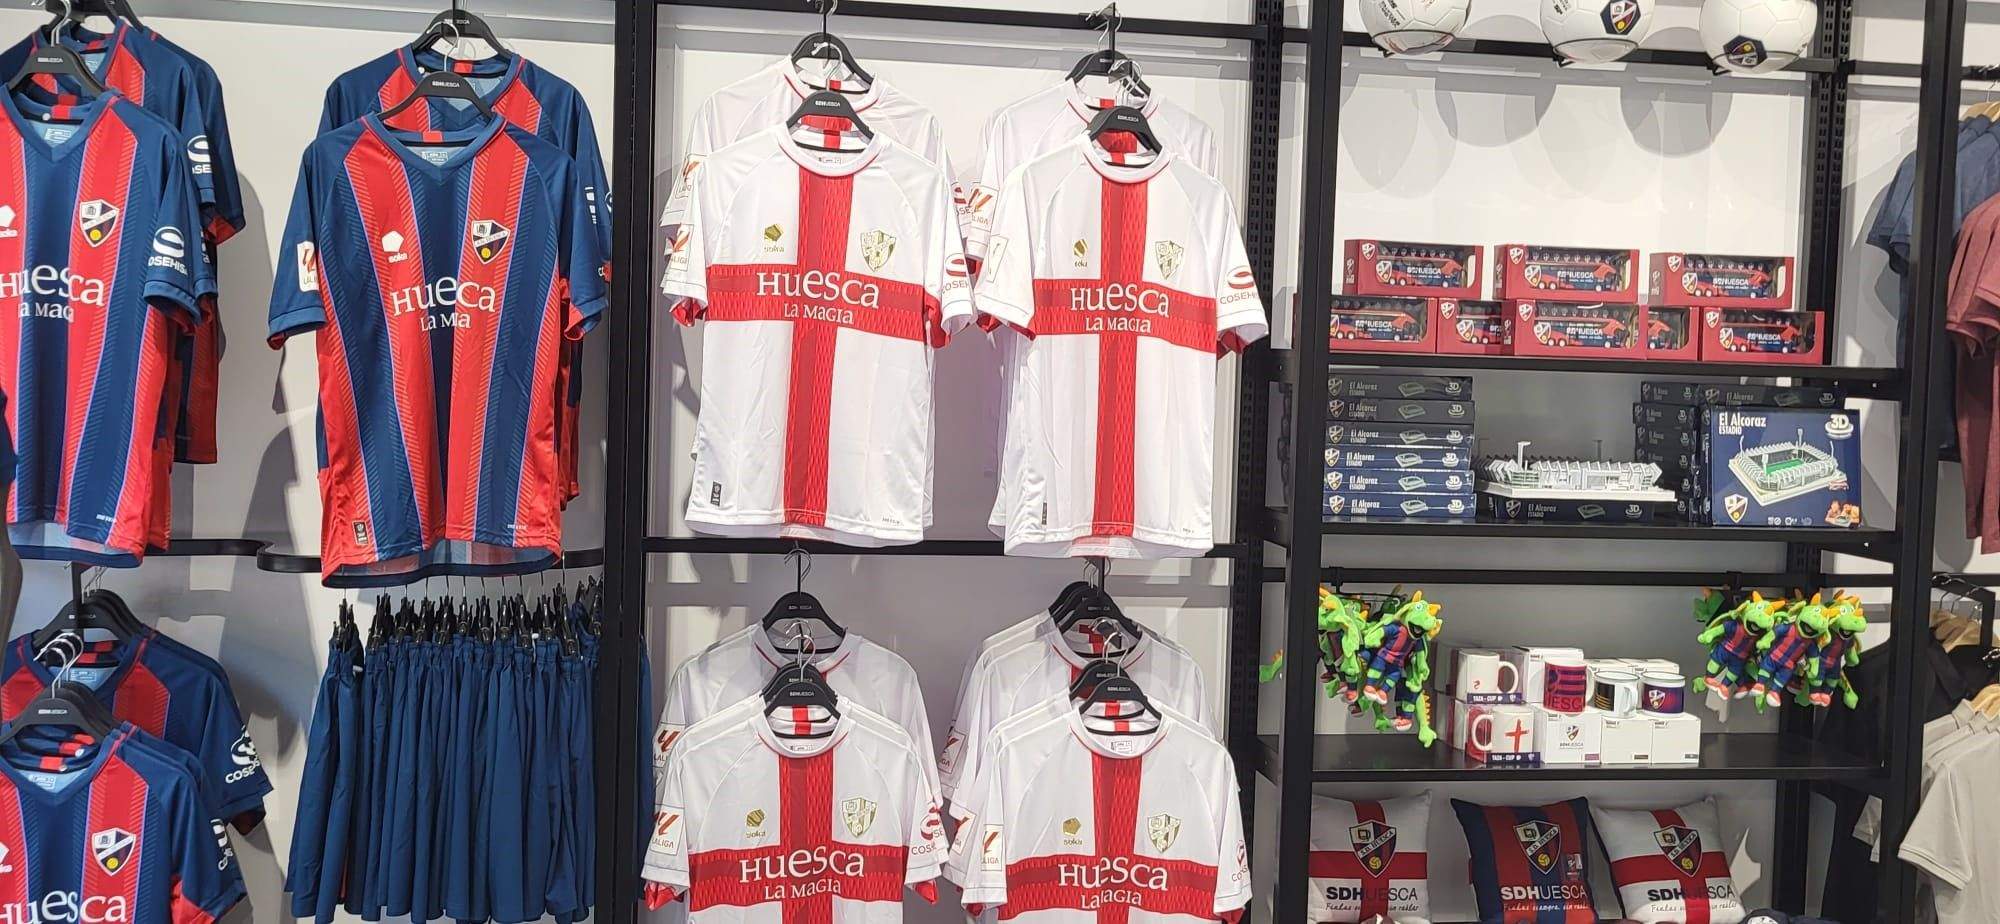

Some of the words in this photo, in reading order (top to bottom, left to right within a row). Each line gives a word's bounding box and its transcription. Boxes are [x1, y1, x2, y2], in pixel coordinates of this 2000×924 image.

[756, 270, 880, 309] Huesca
[1070, 282, 1170, 318] Huesca
[1718, 425, 1743, 436] ESTADIO
[1719, 412, 1729, 427] El
[1730, 411, 1767, 428] Alcoraz
[1831, 413, 1850, 429] 3D
[739, 846, 865, 883] Huesca
[1501, 884, 1588, 900] SDHUESCA
